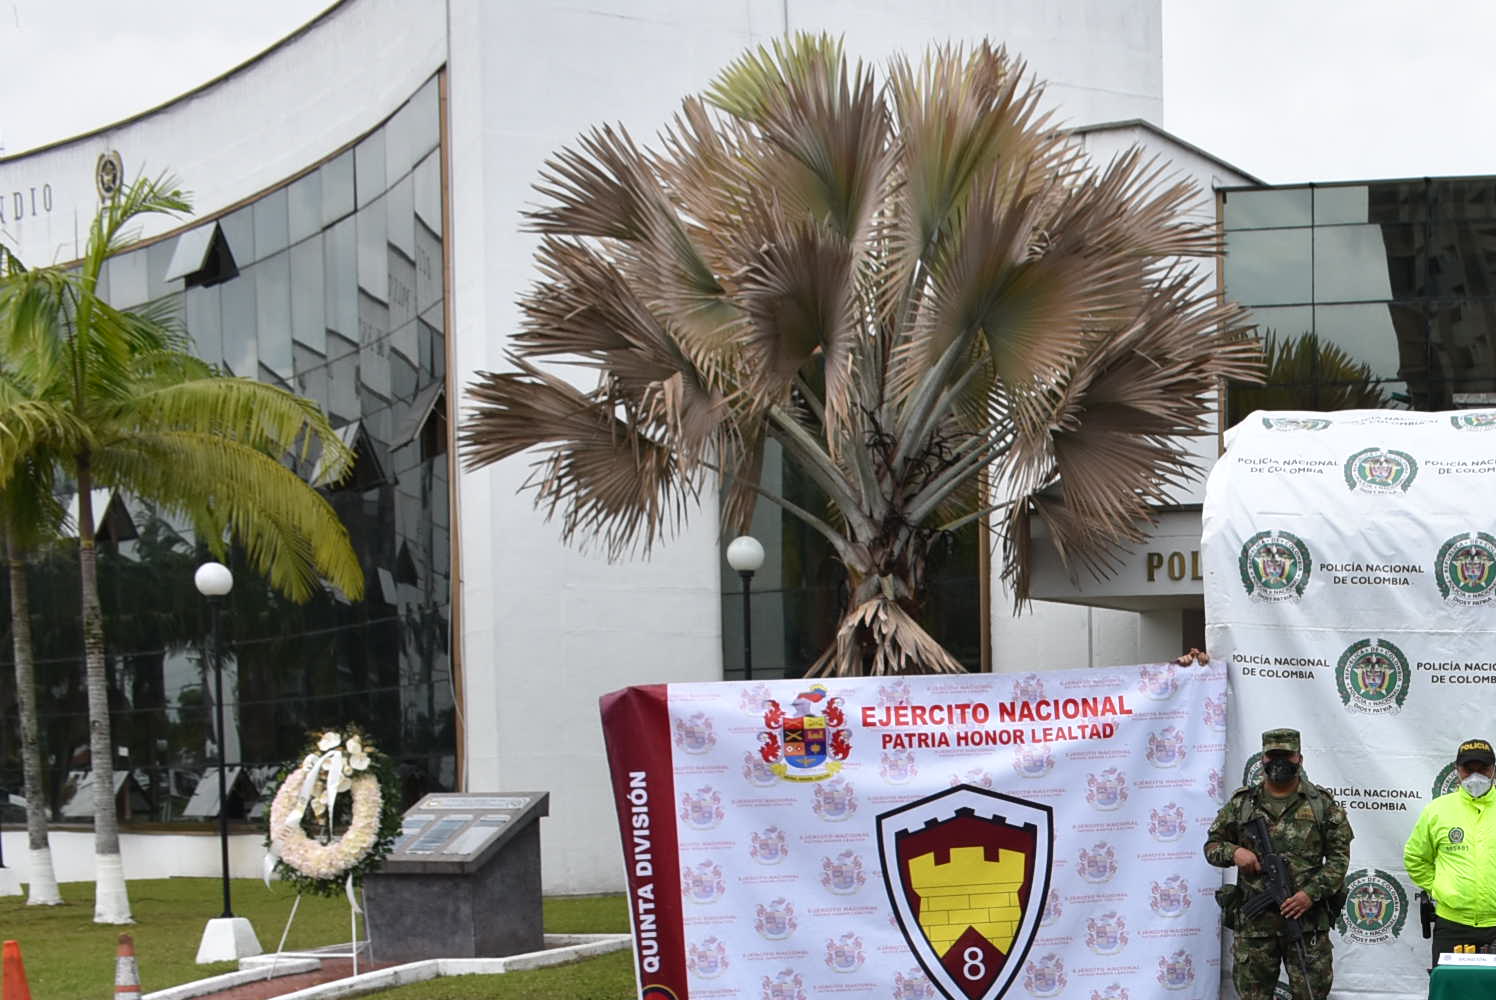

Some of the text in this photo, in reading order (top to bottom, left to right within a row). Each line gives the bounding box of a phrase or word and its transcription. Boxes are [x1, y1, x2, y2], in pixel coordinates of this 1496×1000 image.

[1319, 561, 1424, 574] POLICÍA NACIONAL
[1333, 576, 1410, 586] DE COLOMBIA
[1416, 661, 1460, 671] POLICÍA
[1431, 675, 1447, 684] DE
[998, 695, 1133, 723] NACIONAL
[881, 722, 1115, 750] PATRIA HONOR LEALTAD
[1327, 786, 1423, 799] OLICÍA NACIONAL
[1349, 801, 1407, 811] COLOMBIA
[626, 770, 661, 974] QUINTA DIVISIÓN
[962, 946, 986, 981] 8
